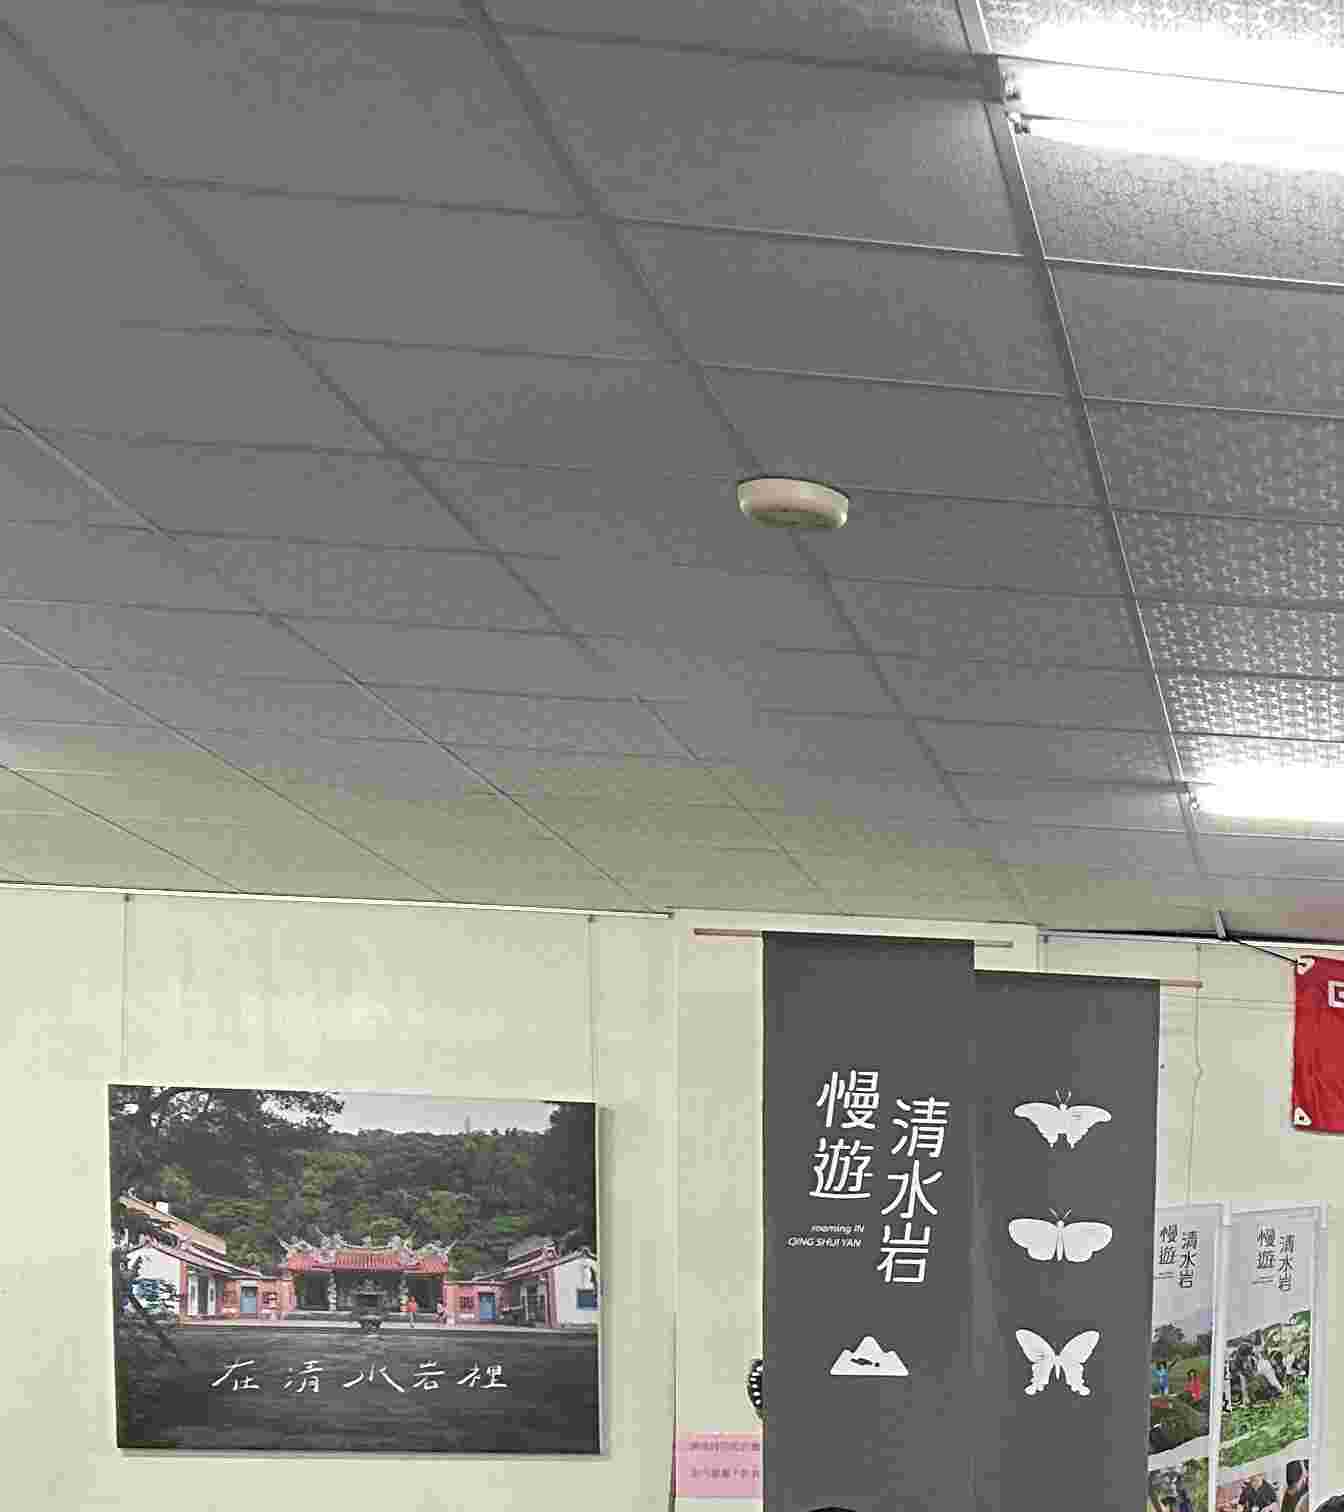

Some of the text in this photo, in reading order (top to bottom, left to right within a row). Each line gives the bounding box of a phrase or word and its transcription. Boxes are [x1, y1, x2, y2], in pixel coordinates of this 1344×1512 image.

[809, 1070, 881, 1200] 慢遊
[877, 1097, 950, 1285] 清水岩
[1179, 1230, 1200, 1289] 清水岩
[1278, 1234, 1296, 1292] 清水岩
[211, 1359, 509, 1394] 在清水岩裡
